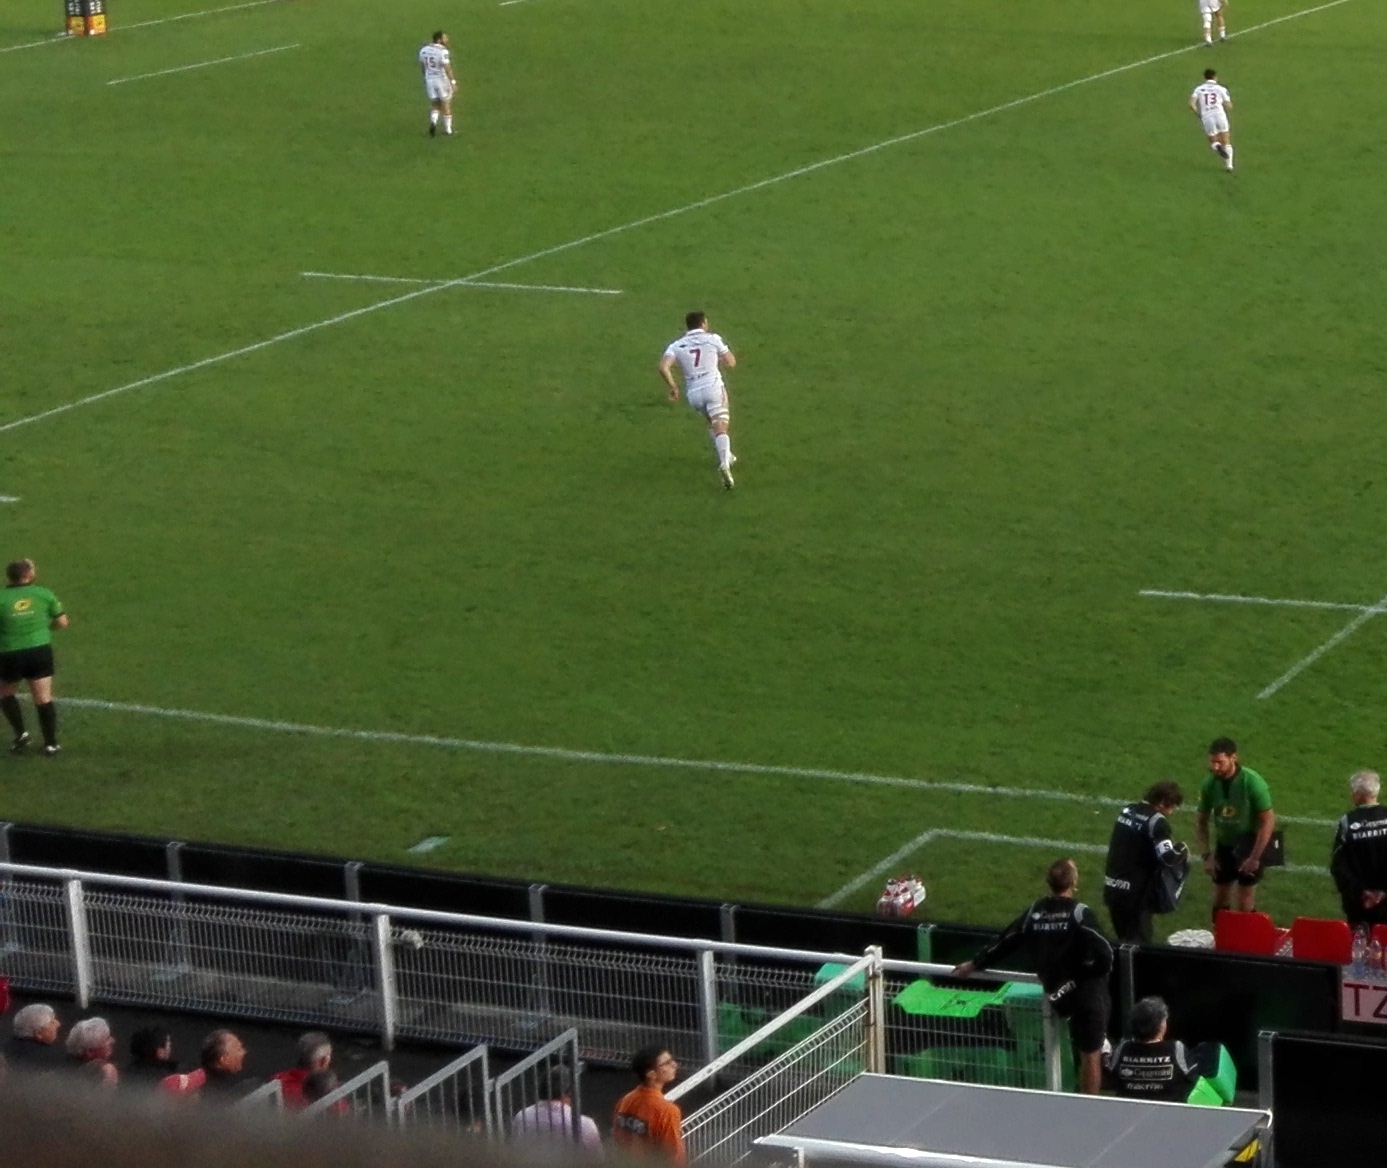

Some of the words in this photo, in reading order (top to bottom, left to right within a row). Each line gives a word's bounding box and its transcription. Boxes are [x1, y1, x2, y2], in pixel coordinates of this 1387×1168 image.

[1204, 92, 1217, 106] 13
[690, 348, 701, 368] 7
[1122, 1055, 1171, 1064] BIARRITZ
